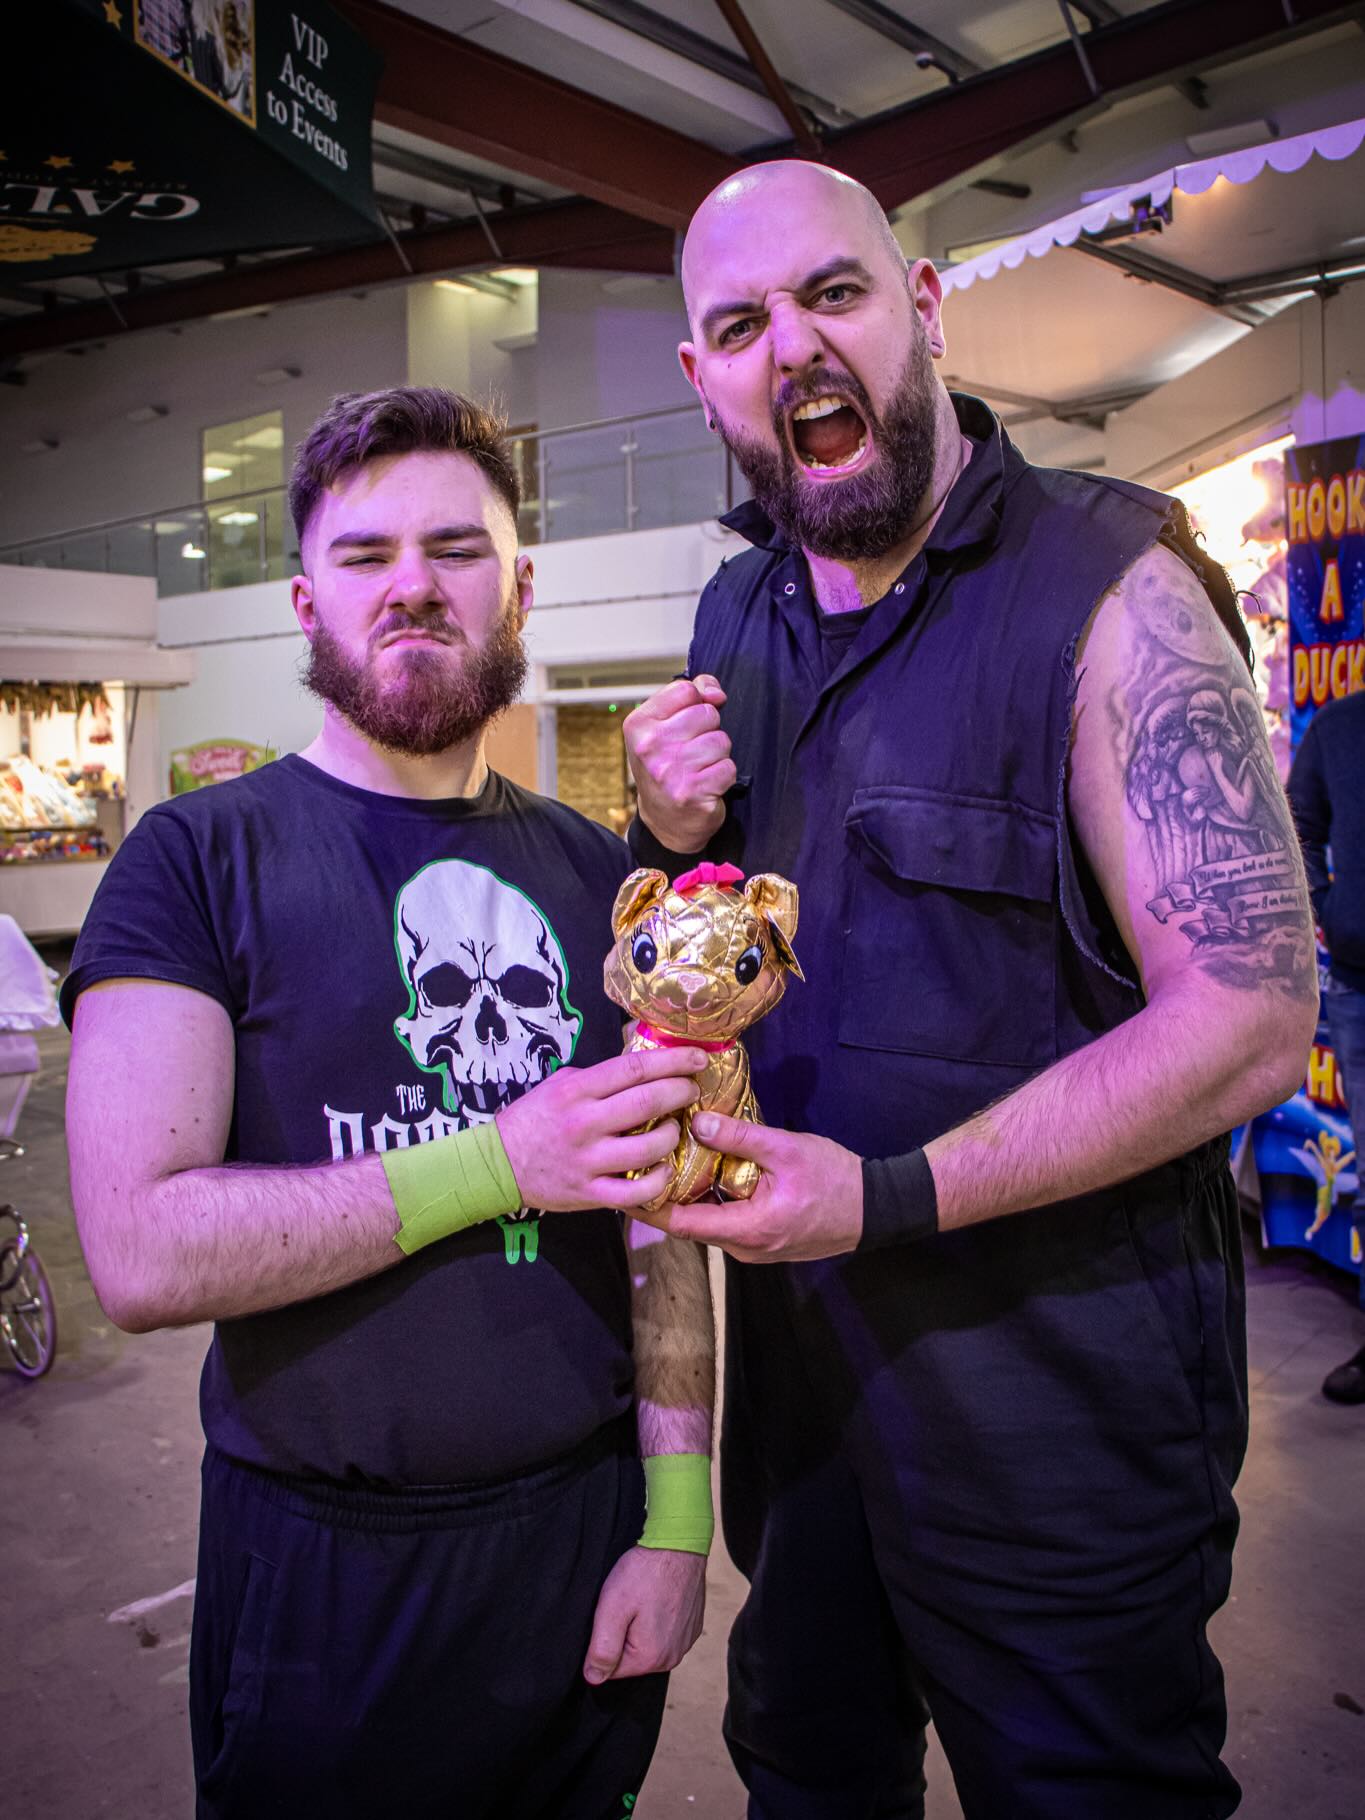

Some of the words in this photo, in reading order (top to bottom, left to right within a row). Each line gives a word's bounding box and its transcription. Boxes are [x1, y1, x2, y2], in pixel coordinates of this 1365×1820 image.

[290, 12, 329, 71] VIP
[278, 51, 339, 123] Access
[266, 89, 290, 126] to
[291, 98, 349, 172] Events
[0, 182, 201, 221] GAL
[1287, 470, 1365, 544] HOOK
[1319, 558, 1345, 624] A
[1293, 641, 1365, 708] DUCK
[396, 1084, 427, 1116] THE
